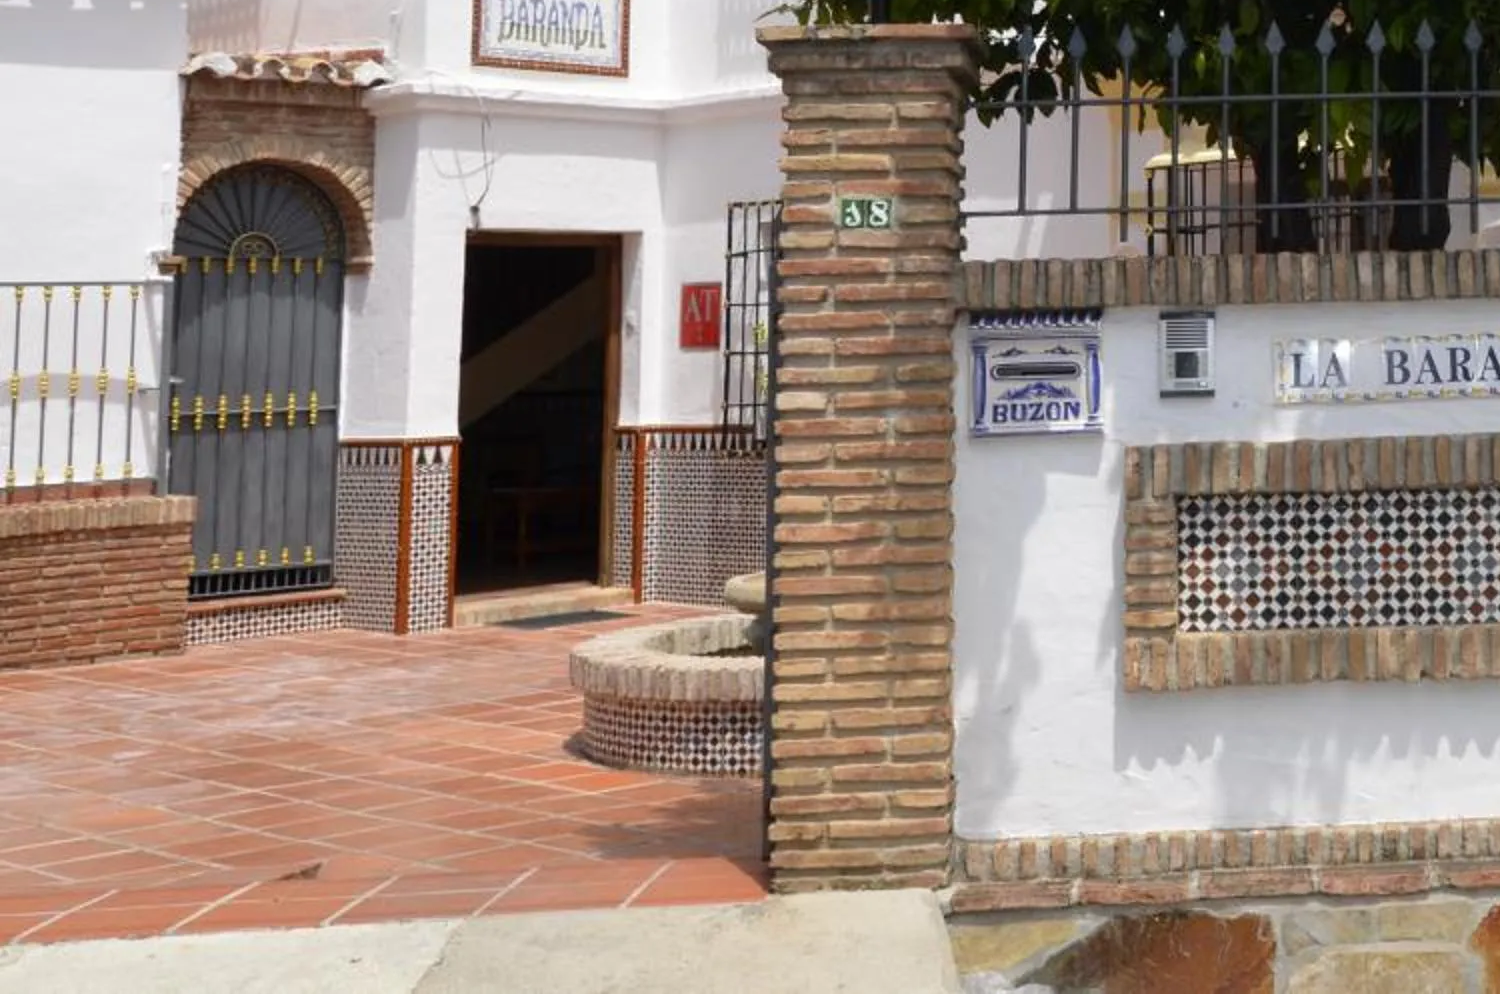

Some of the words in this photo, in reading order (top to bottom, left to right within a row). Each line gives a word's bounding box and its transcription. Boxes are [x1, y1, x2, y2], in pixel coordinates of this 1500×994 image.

[844, 201, 889, 226] 38
[684, 288, 719, 323] AT
[1289, 351, 1348, 389] LA
[991, 401, 1081, 424] BUZON
